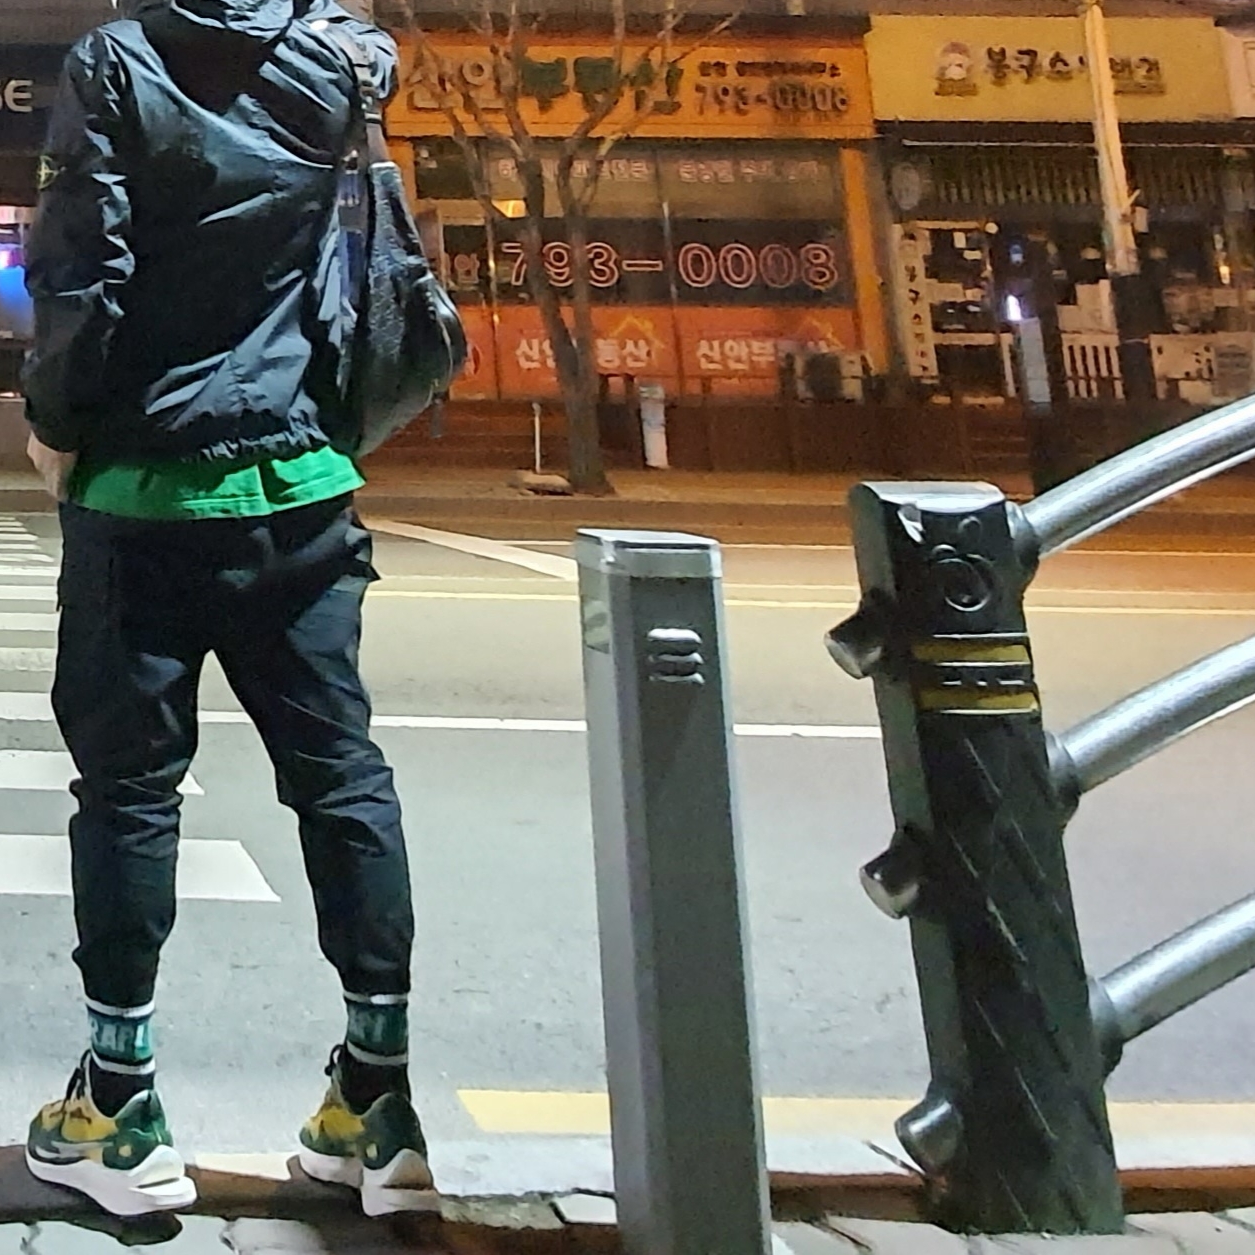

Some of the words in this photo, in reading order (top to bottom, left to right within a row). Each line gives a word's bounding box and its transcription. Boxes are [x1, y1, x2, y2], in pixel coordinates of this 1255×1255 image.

[986, 46, 1163, 88] 봉구스버거
[501, 241, 839, 291] 793-0008
[515, 338, 650, 369] 신안동산
